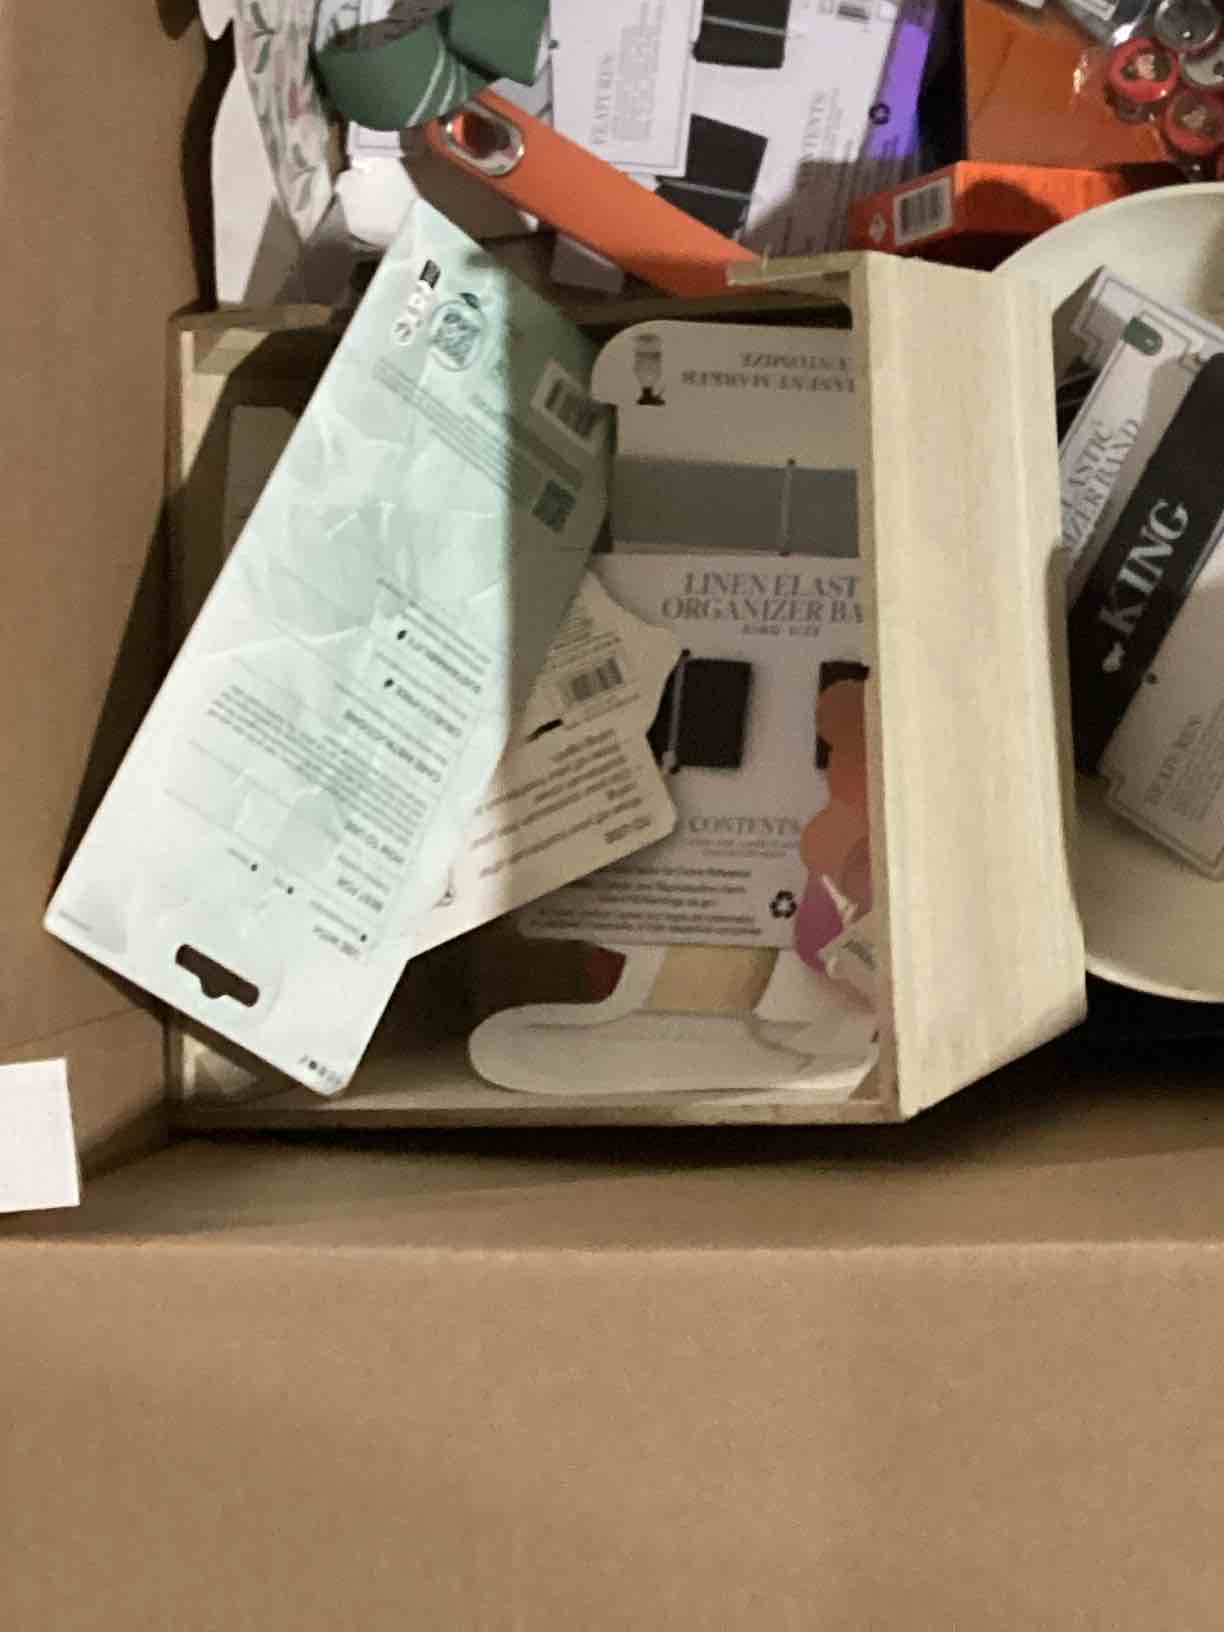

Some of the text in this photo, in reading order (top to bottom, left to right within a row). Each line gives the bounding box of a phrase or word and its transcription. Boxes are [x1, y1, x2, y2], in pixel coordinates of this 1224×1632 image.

[681, 370, 769, 389] MARKER
[1099, 497, 1191, 634] KING
[682, 571, 862, 598] LINEN ELAST
[661, 598, 864, 624] ORGANIZER BA
